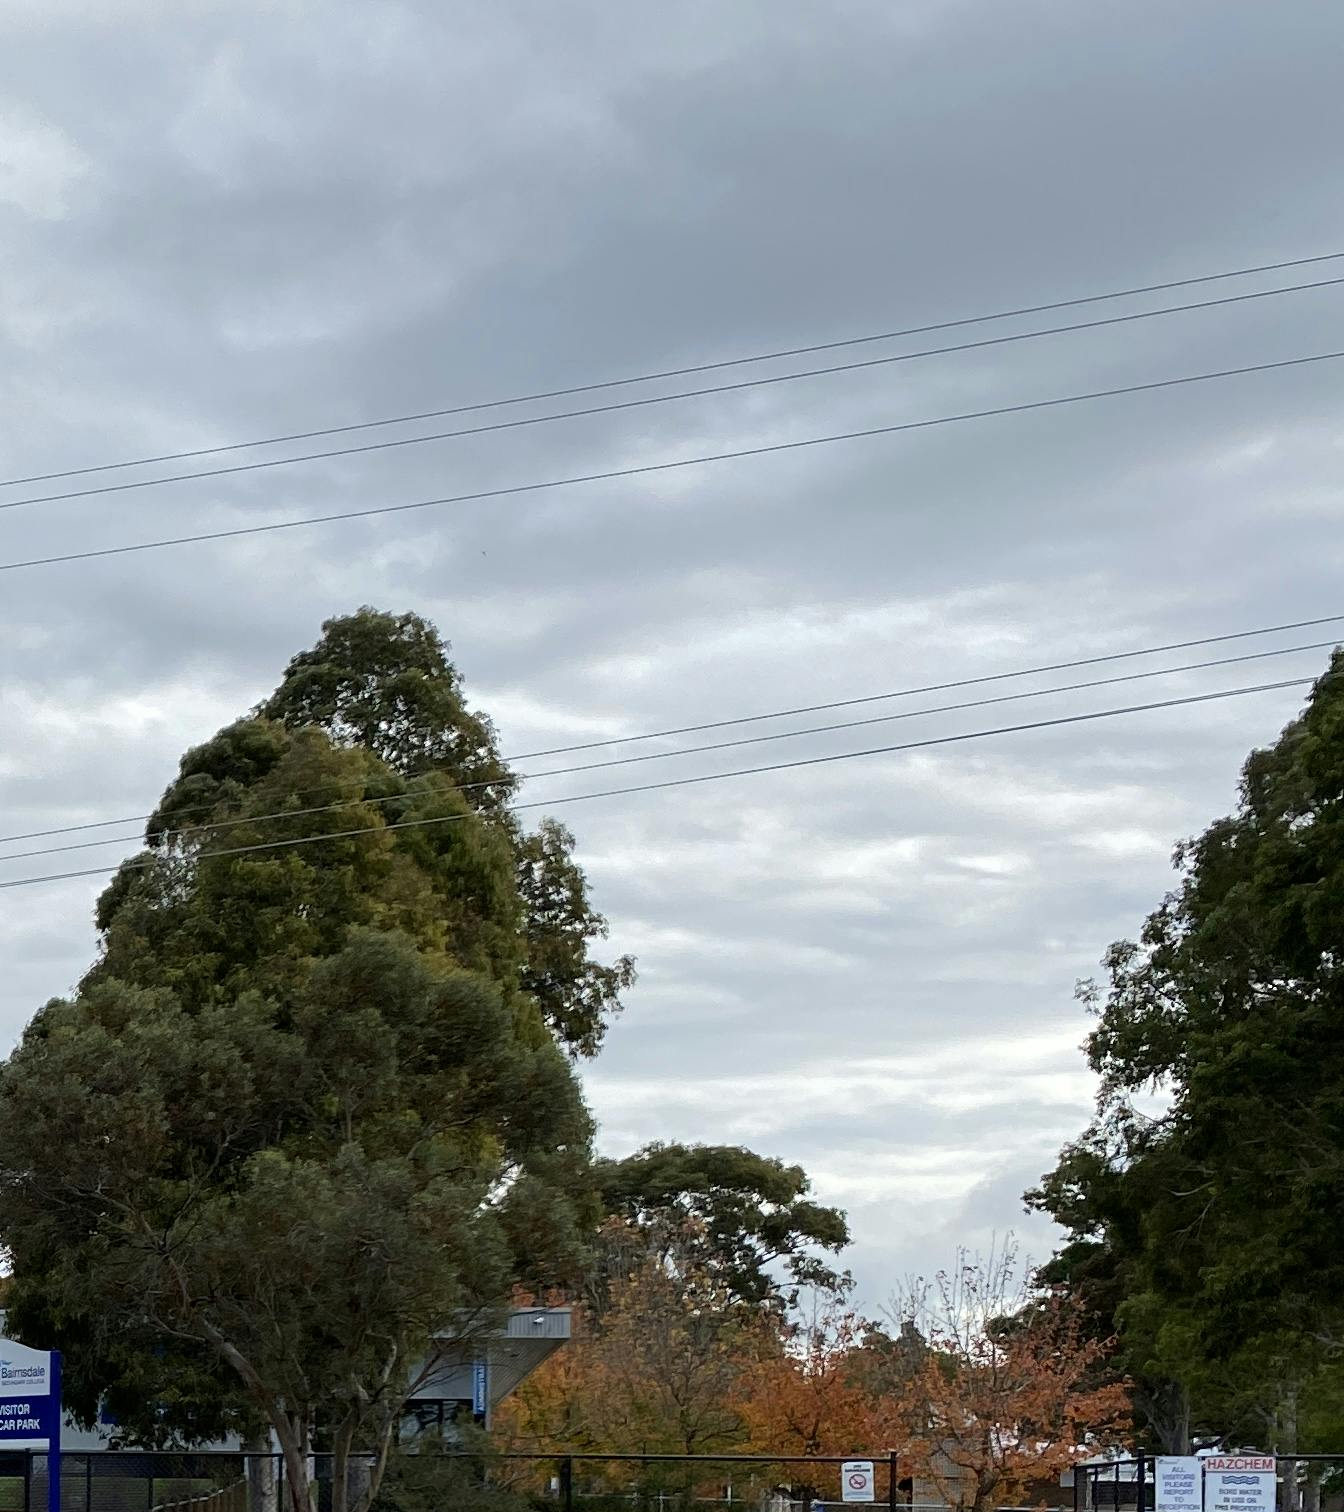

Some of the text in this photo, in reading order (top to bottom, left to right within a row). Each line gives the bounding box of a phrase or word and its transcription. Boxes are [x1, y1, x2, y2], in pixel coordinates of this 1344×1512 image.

[2, 1365, 45, 1378] Bairnsdale
[17, 1419, 40, 1430] PARK
[1207, 1459, 1273, 1469] HAZCHEM
